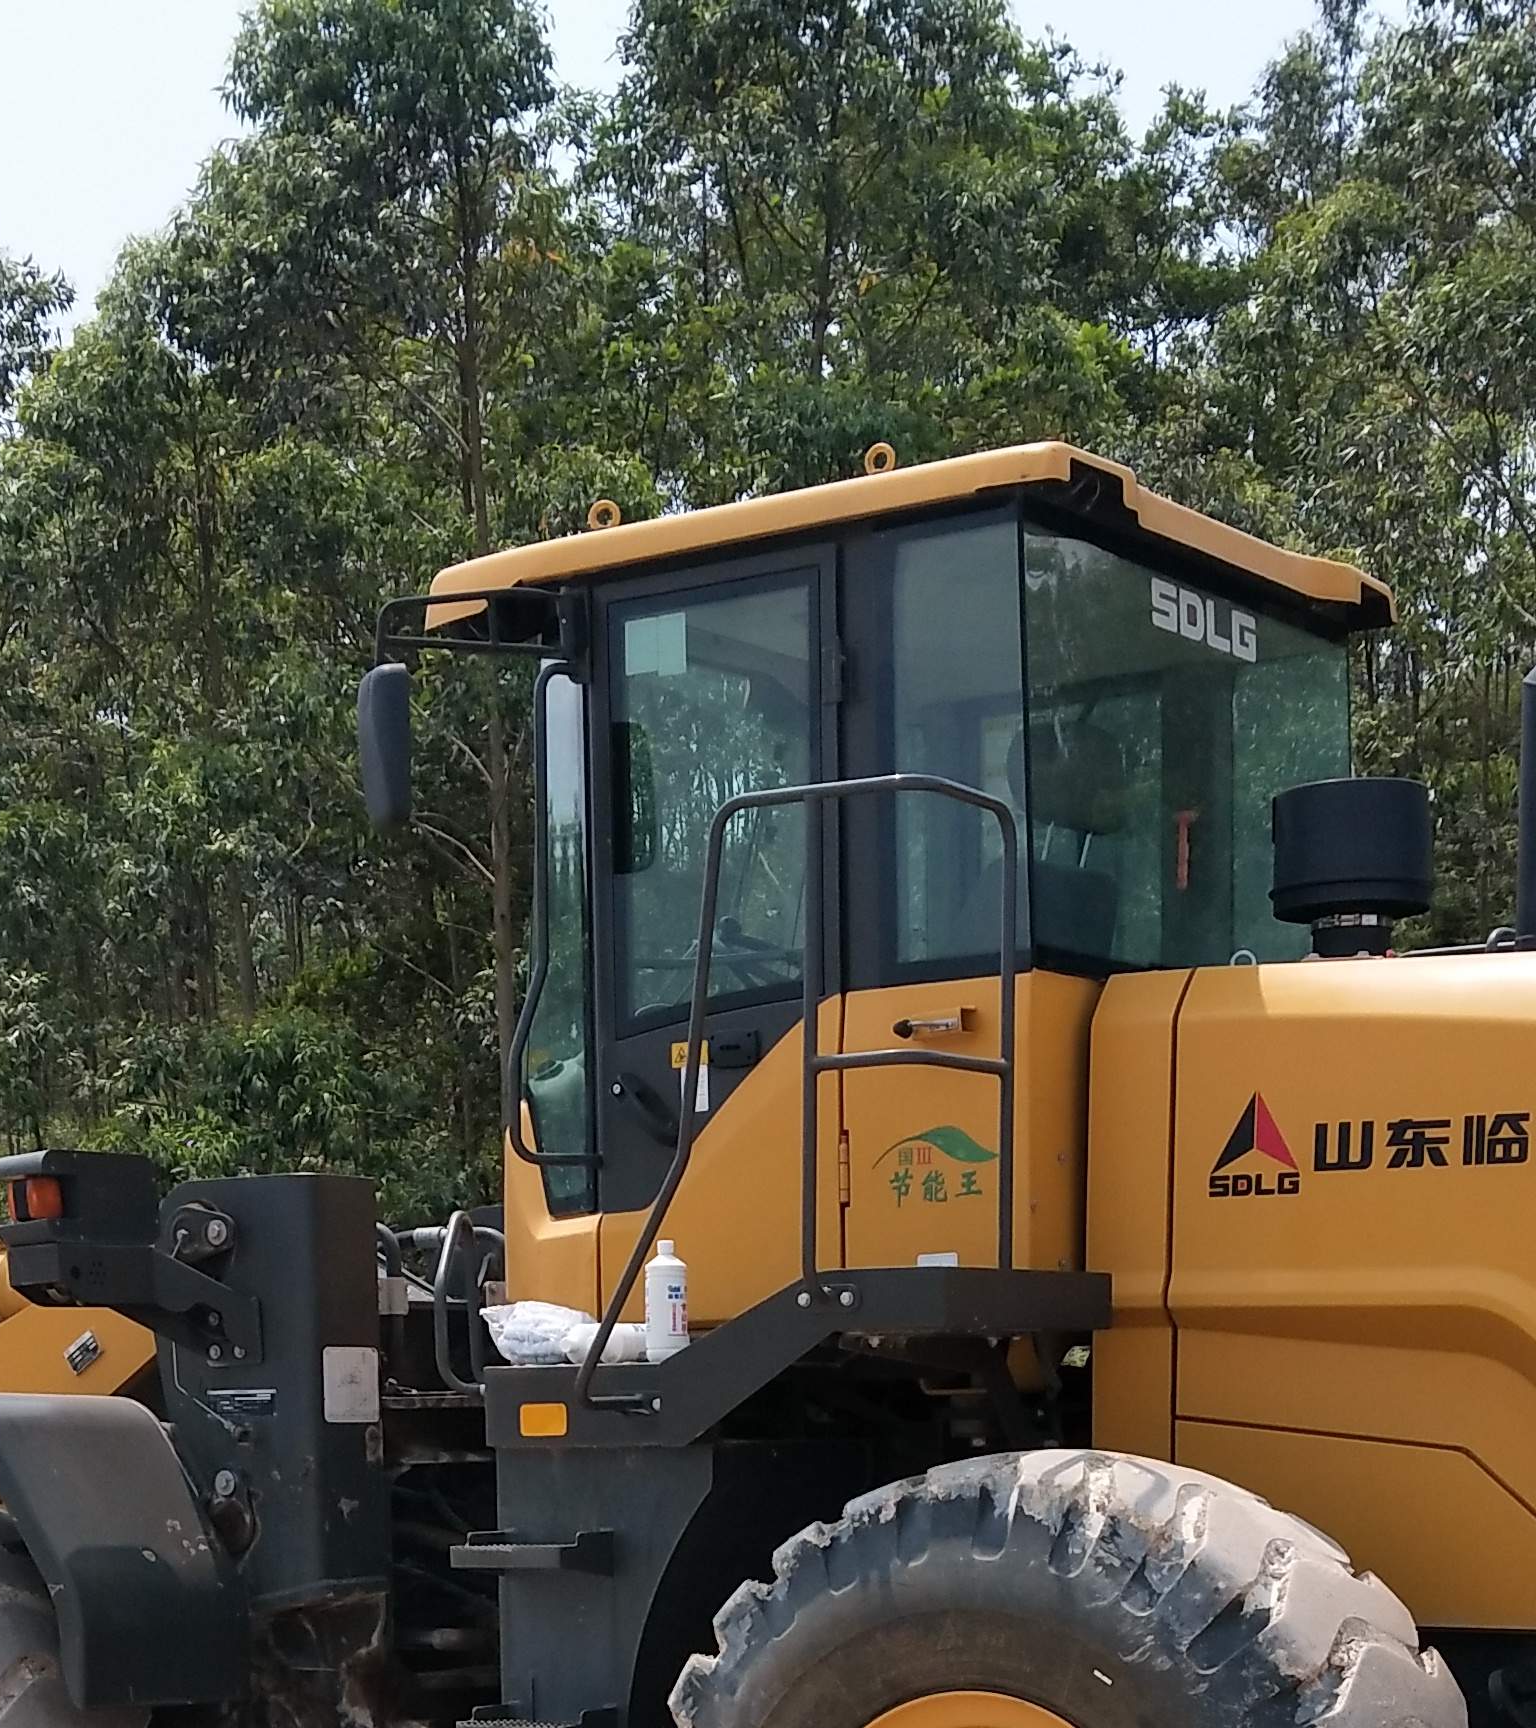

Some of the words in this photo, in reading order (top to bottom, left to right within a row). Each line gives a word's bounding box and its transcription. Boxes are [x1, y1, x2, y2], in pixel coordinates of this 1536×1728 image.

[1151, 577, 1257, 664] SDLG
[889, 1167, 983, 1208] 节能王
[1208, 1171, 1301, 1198] SDLG
